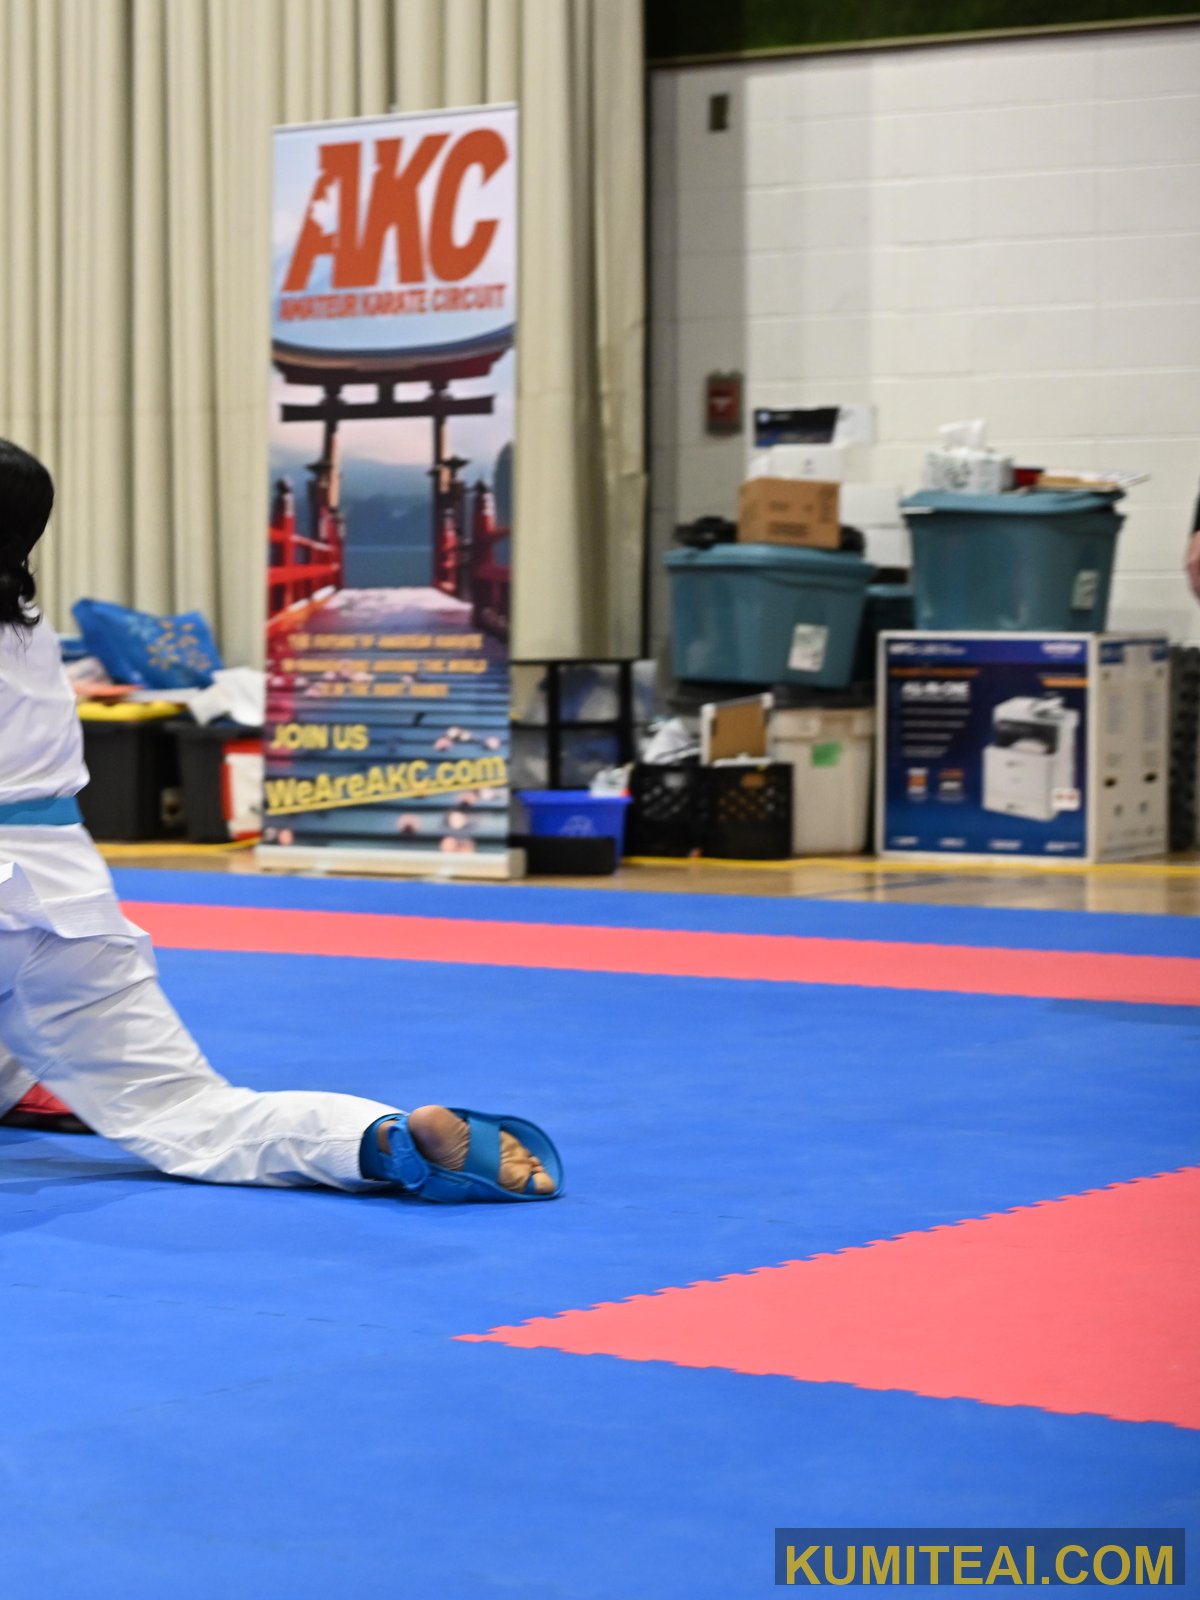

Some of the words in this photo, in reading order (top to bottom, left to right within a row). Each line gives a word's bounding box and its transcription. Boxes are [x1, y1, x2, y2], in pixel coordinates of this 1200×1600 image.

[282, 128, 508, 292] AKC
[279, 293, 356, 322] AMATEUR
[362, 289, 427, 317] KARATE
[432, 284, 506, 313] CIRCUIT
[270, 723, 329, 749] JOIN
[332, 724, 369, 750] US
[265, 756, 506, 808] WeAreAKC.com
